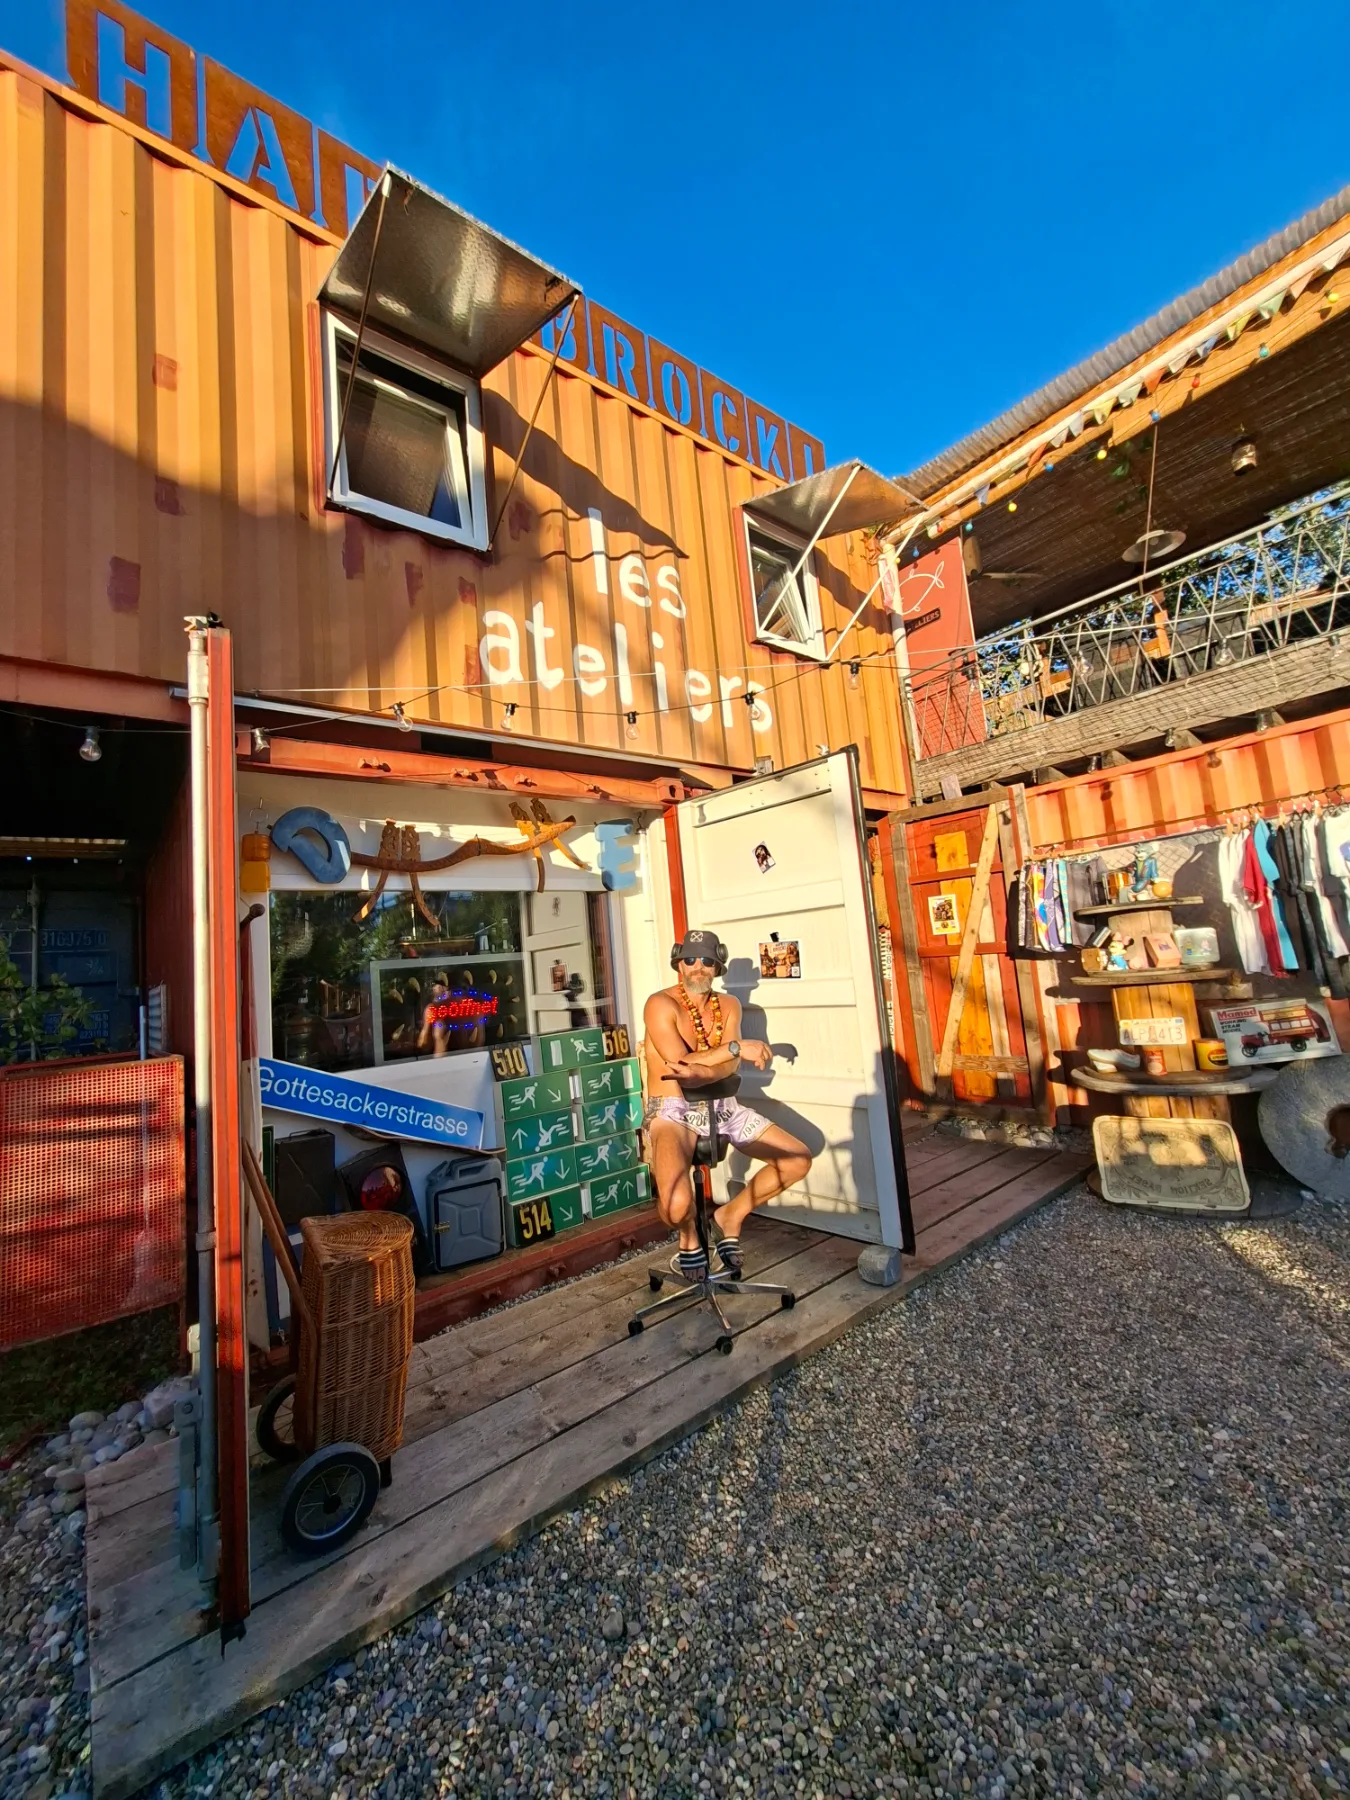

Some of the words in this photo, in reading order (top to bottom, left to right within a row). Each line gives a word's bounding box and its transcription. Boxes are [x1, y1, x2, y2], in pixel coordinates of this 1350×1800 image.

[588, 508, 687, 619] les
[480, 602, 773, 732] ateliers
[426, 996, 498, 1024] geöffnet
[1216, 1007, 1258, 1021] Mamod
[605, 1029, 630, 1057] 516
[492, 1046, 526, 1076] 510
[259, 1066, 469, 1137] Gottesackerstrasse
[519, 1203, 552, 1240] 514
